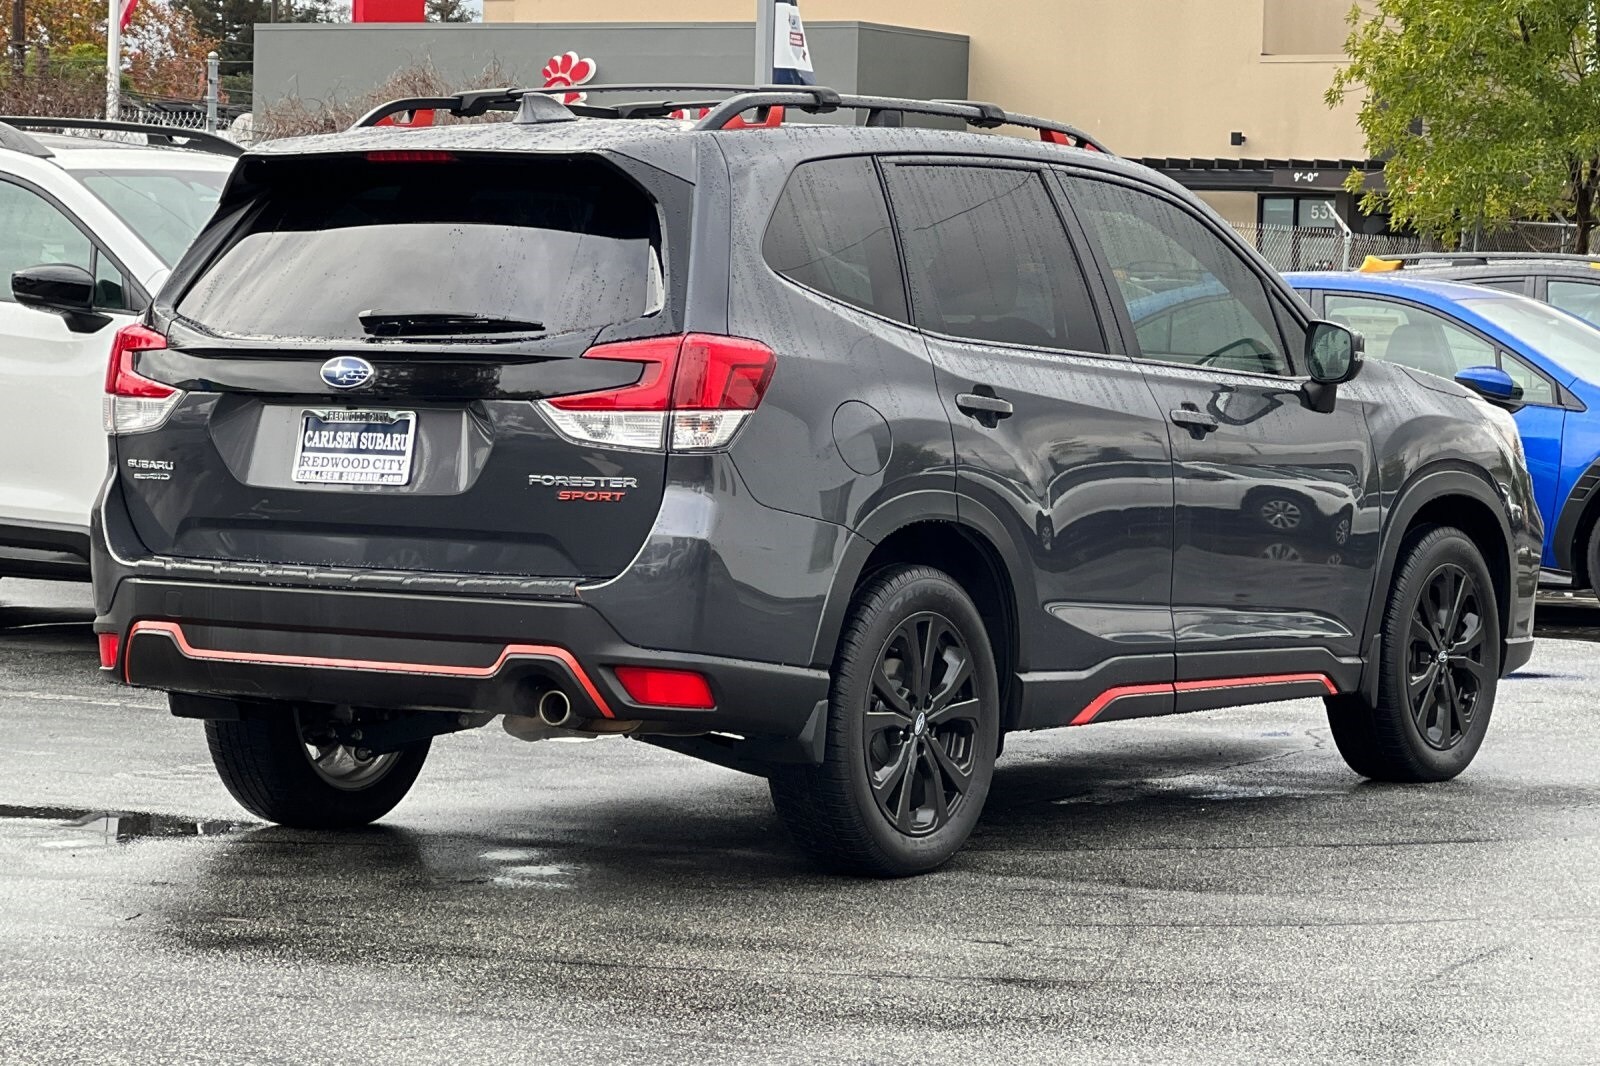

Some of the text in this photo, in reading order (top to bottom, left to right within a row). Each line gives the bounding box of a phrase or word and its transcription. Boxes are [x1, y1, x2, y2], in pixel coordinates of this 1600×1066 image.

[304, 430, 359, 448] CARLSEN
[127, 458, 174, 470] SUBARU
[300, 456, 405, 471] REDWOOD CITY
[528, 474, 638, 488] FORESTER
[557, 490, 626, 502] SPORT
